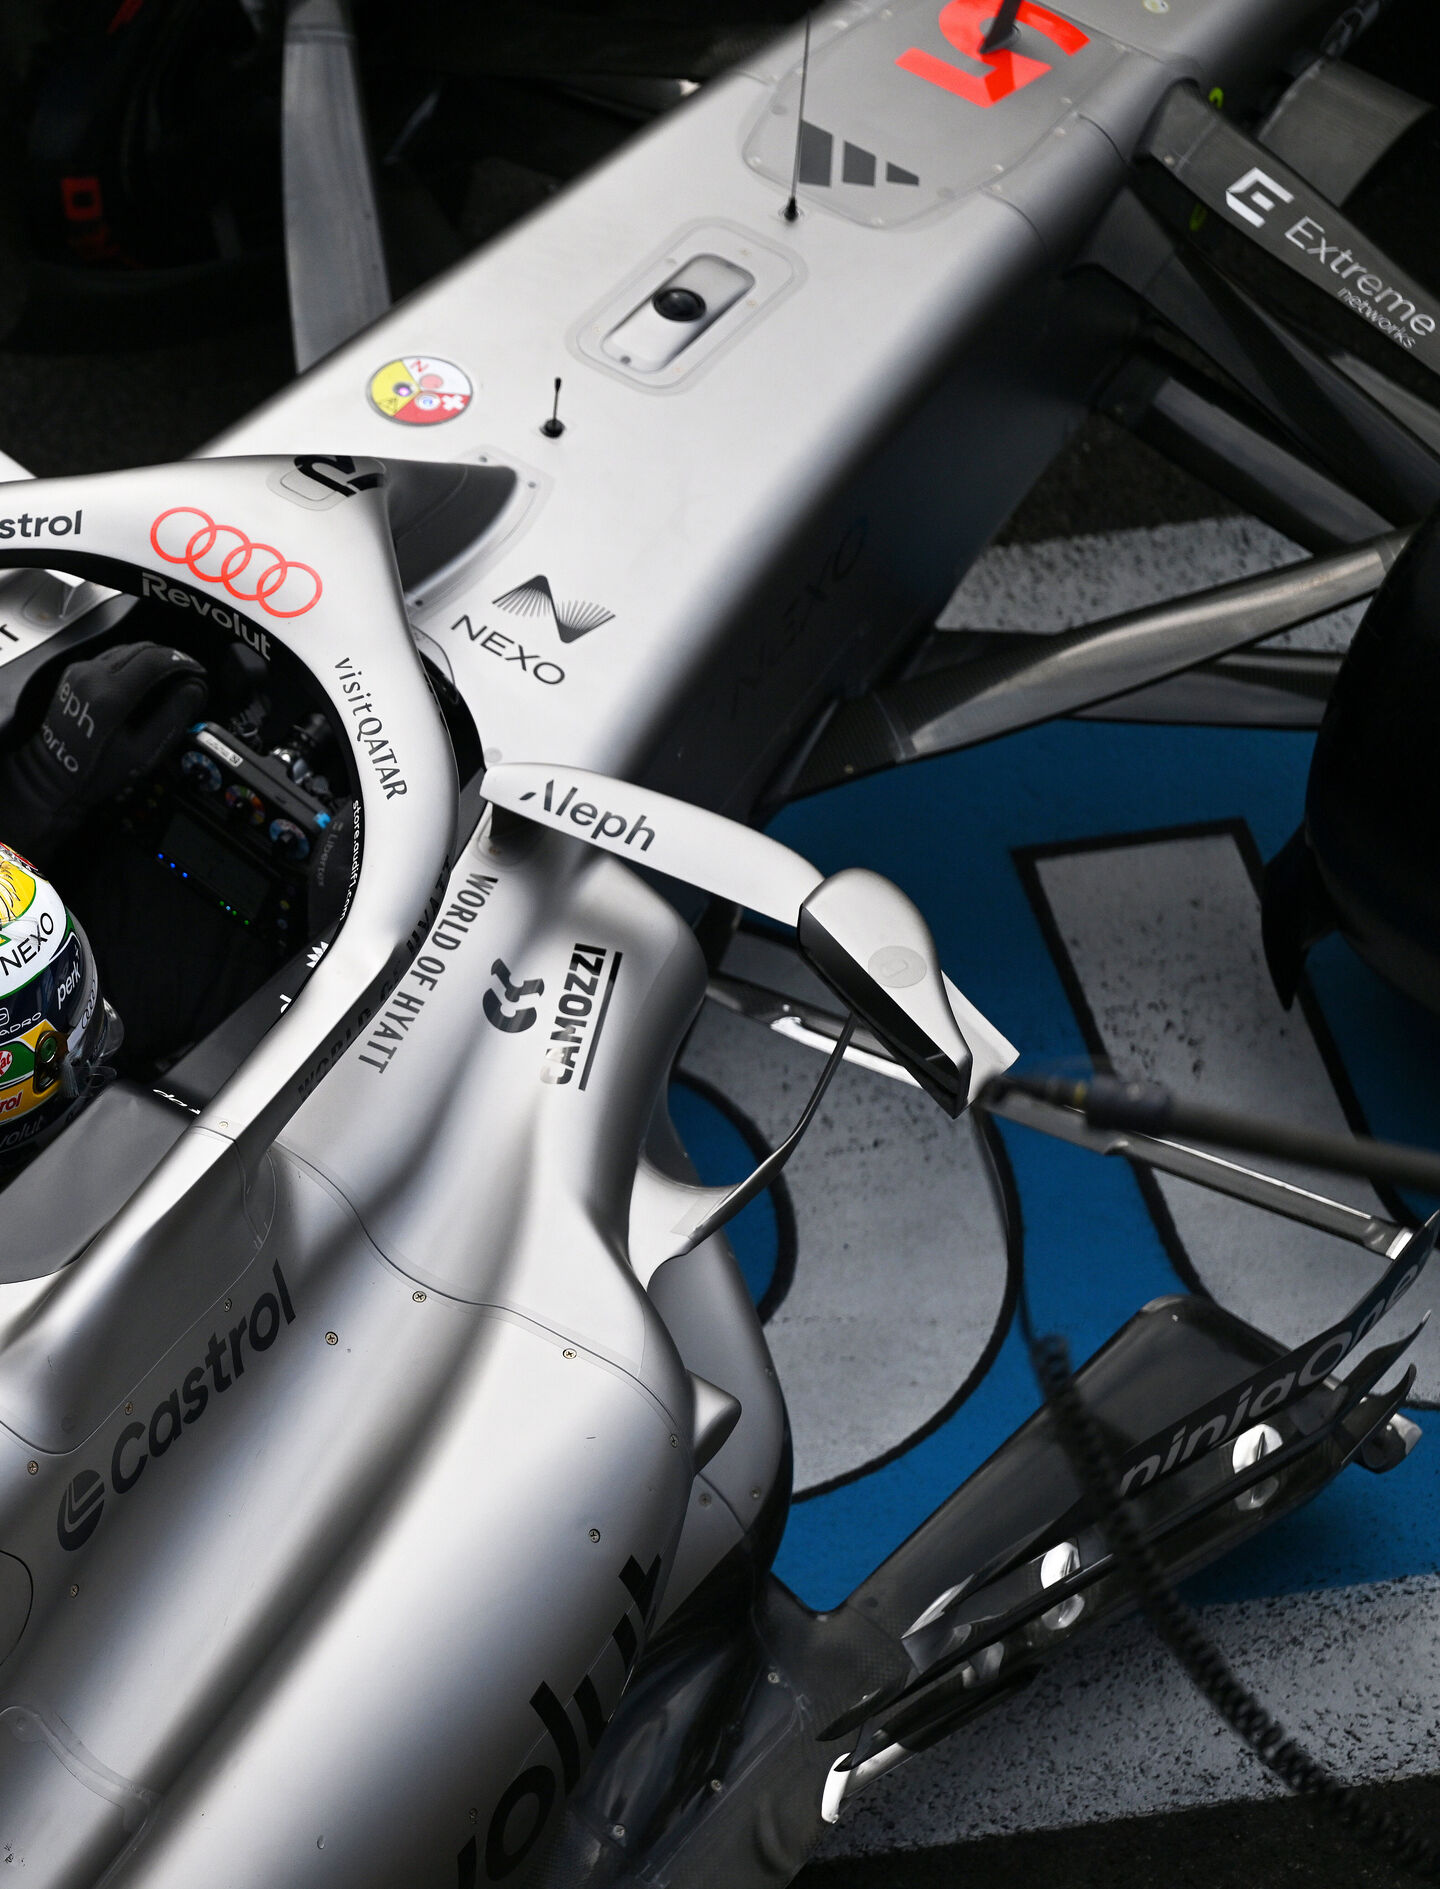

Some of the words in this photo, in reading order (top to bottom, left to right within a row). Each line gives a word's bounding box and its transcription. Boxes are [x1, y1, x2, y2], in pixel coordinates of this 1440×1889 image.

[895, 0, 1091, 108] 5
[1284, 216, 1436, 336] Extreme
[1337, 287, 1416, 349] networks
[142, 572, 271, 661] Revolut
[451, 614, 565, 685] NEXO
[334, 657, 408, 800] visitQATAR
[519, 779, 657, 851] Aleph
[339, 799, 361, 921] store.audif1.com
[0, 912, 54, 976] NEXO
[431, 873, 499, 951] WORLD
[57, 961, 81, 1010] perk
[410, 955, 446, 991] OF
[540, 943, 608, 1085] CAMOZZI
[358, 991, 425, 1074] HYATT
[112, 1258, 296, 1494] Castrol
[1119, 1263, 1419, 1496] ninjaOne
